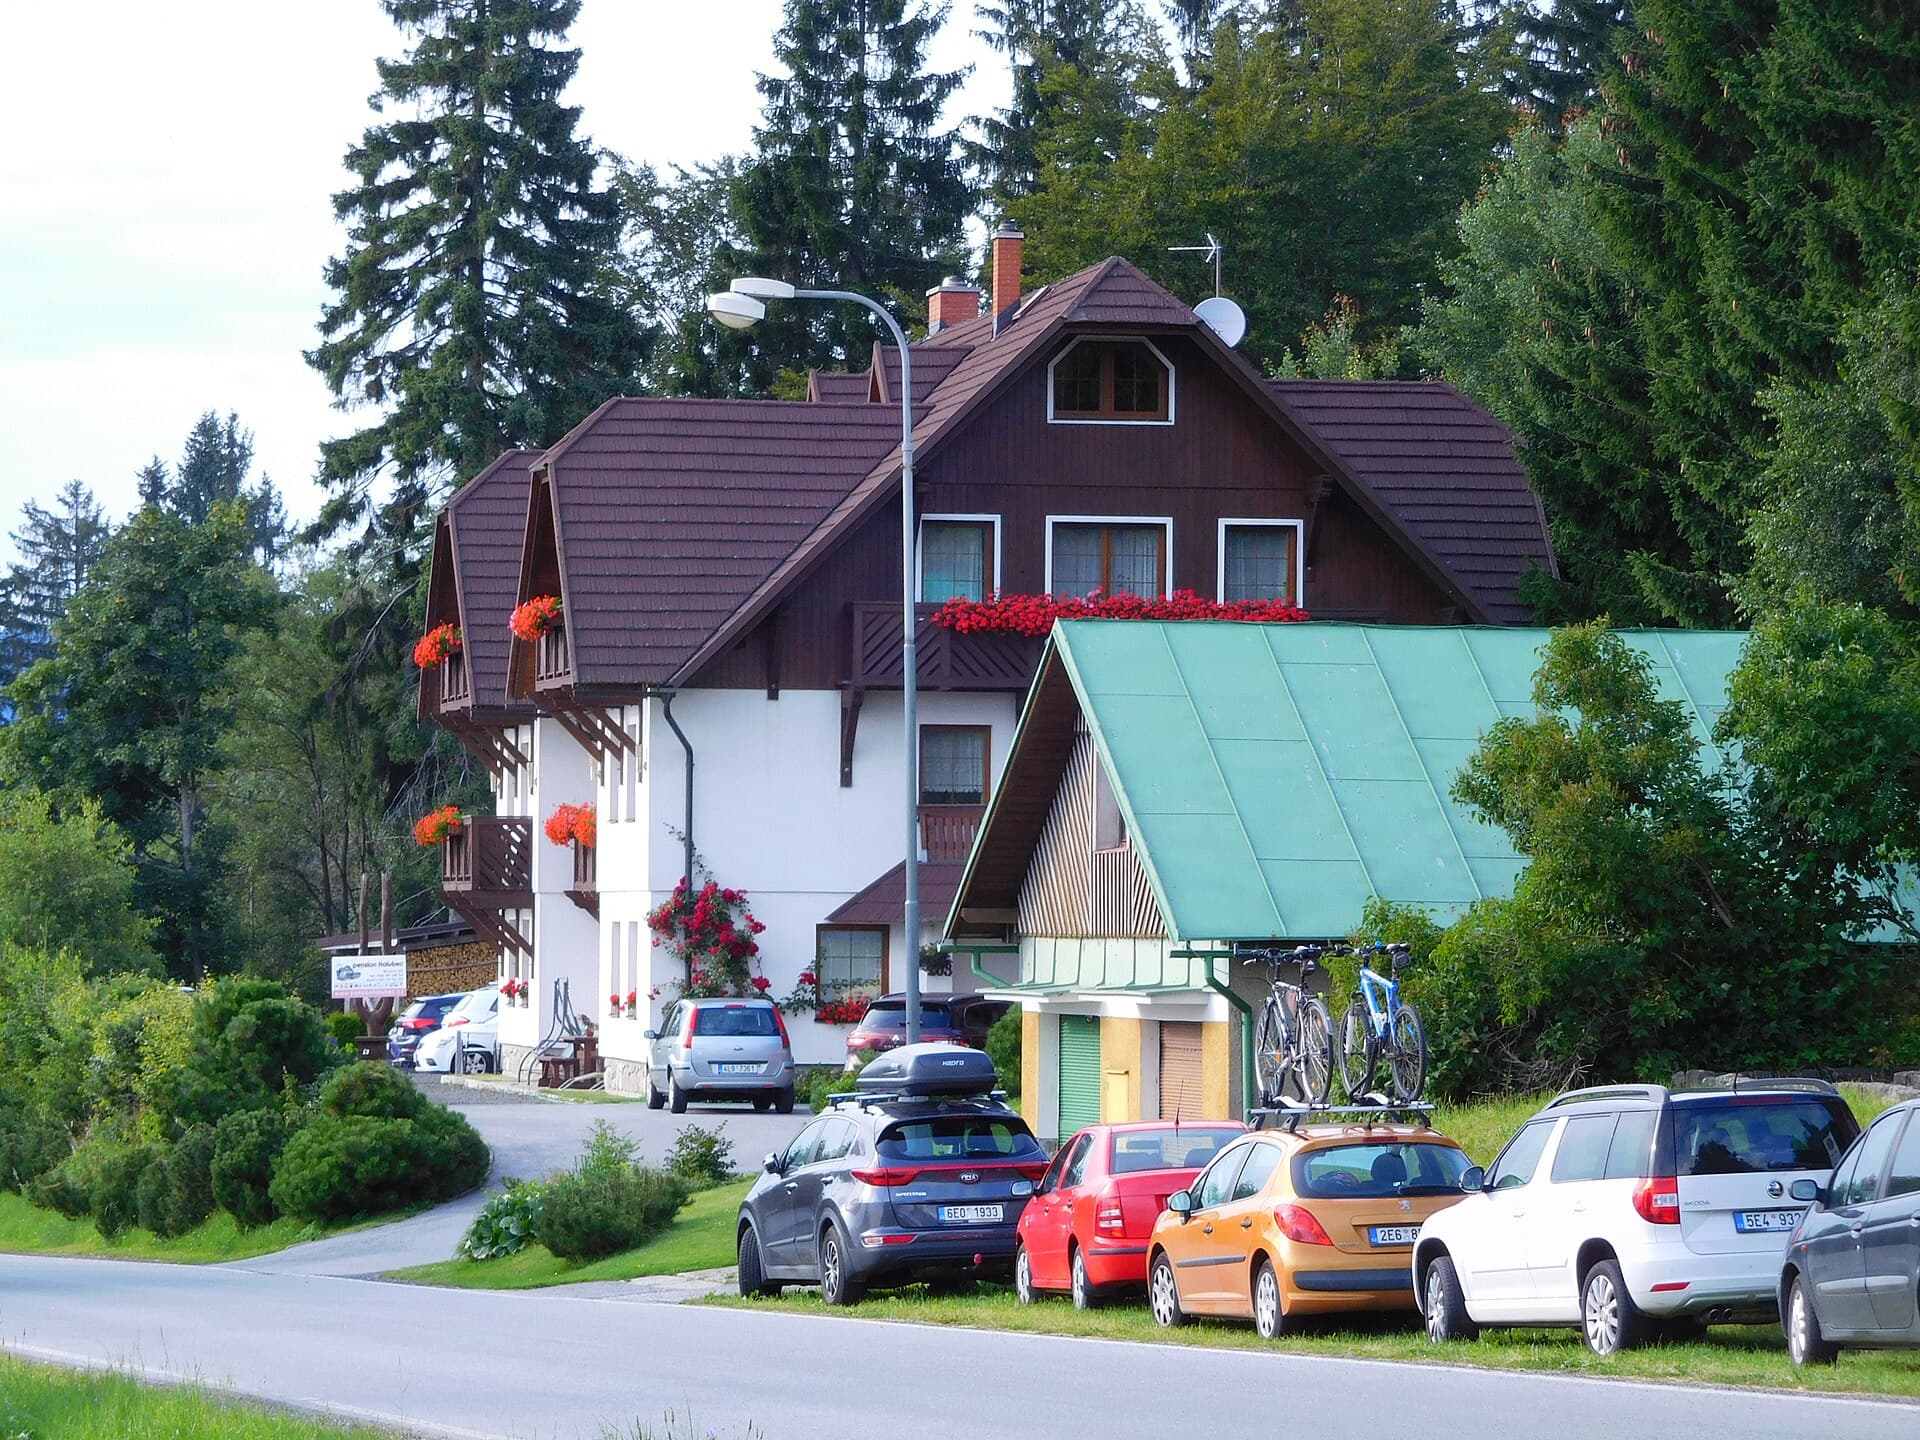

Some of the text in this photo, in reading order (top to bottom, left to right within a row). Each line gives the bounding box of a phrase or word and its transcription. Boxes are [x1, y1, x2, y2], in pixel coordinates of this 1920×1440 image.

[974, 1206, 998, 1218] 1933
[1745, 1213, 1770, 1228] 5E4
[1380, 1229, 1402, 1241] 2E6
